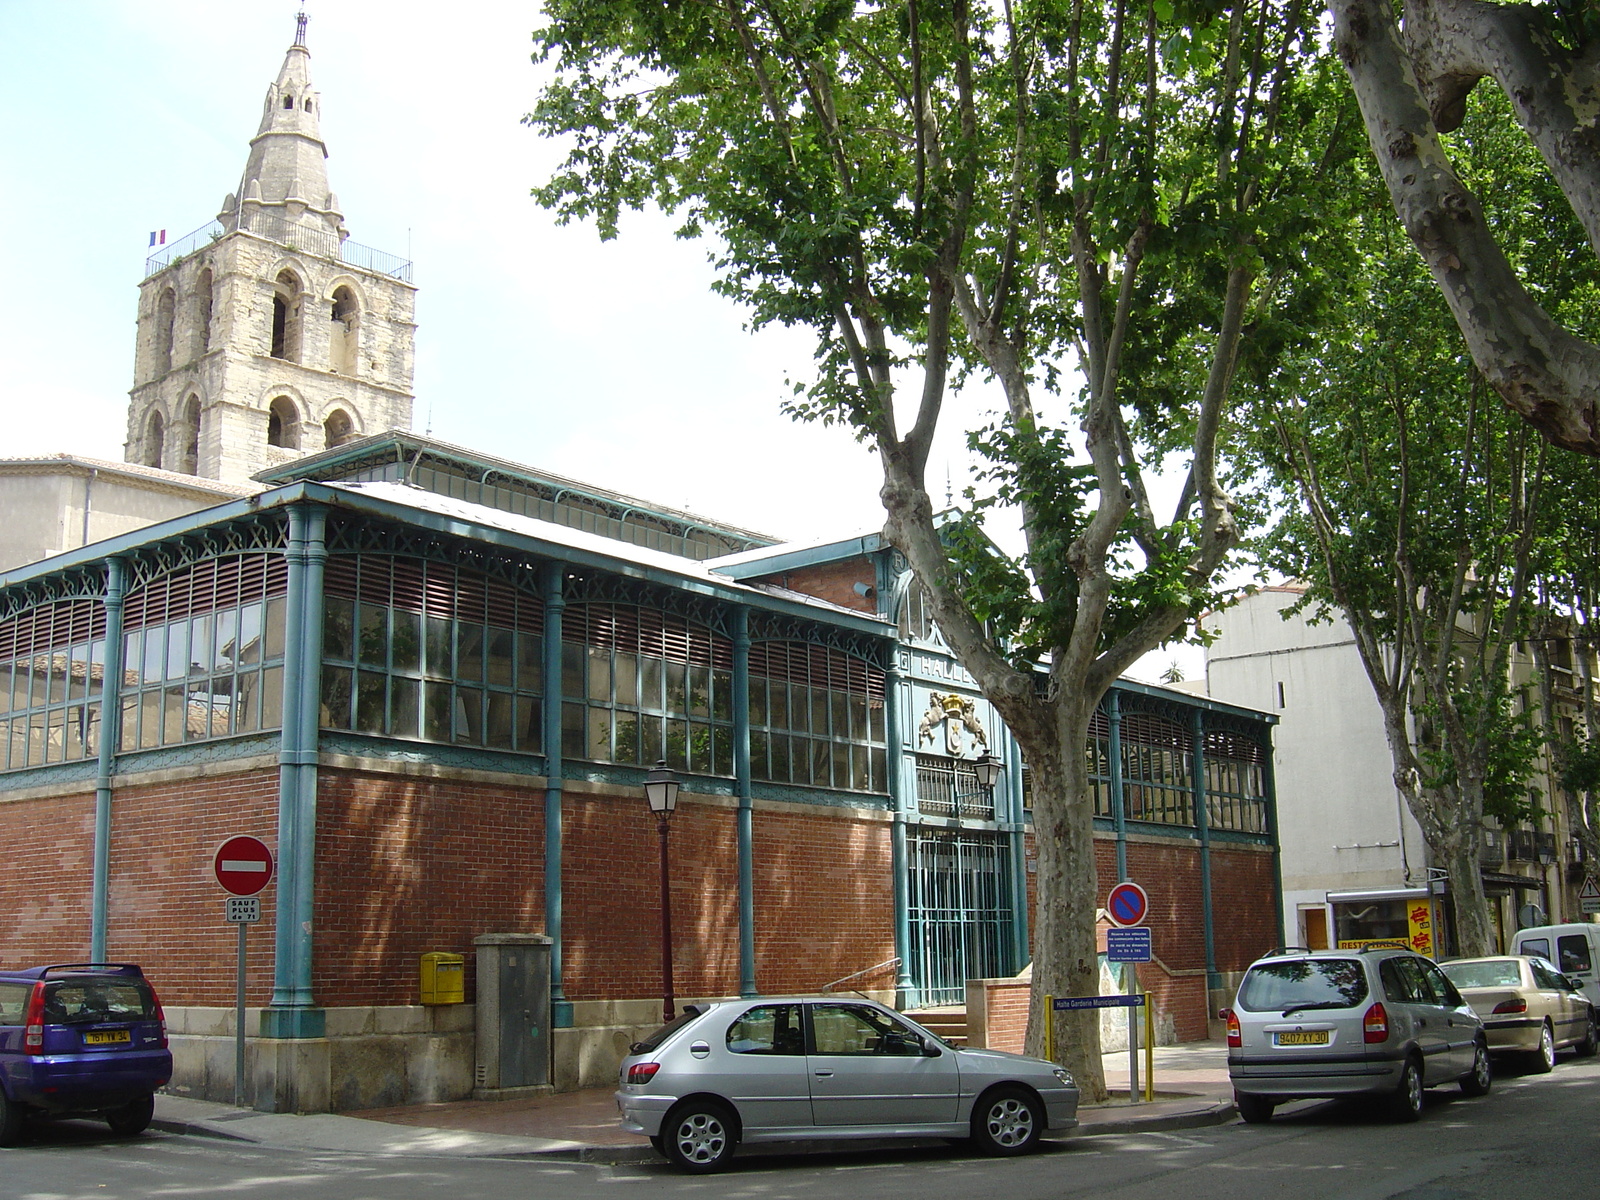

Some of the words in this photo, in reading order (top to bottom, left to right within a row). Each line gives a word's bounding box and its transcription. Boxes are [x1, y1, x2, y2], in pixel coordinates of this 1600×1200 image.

[1280, 1033, 1300, 1043] 9407
[1302, 1034, 1313, 1042] XY
[1315, 1033, 1326, 1042] 30
